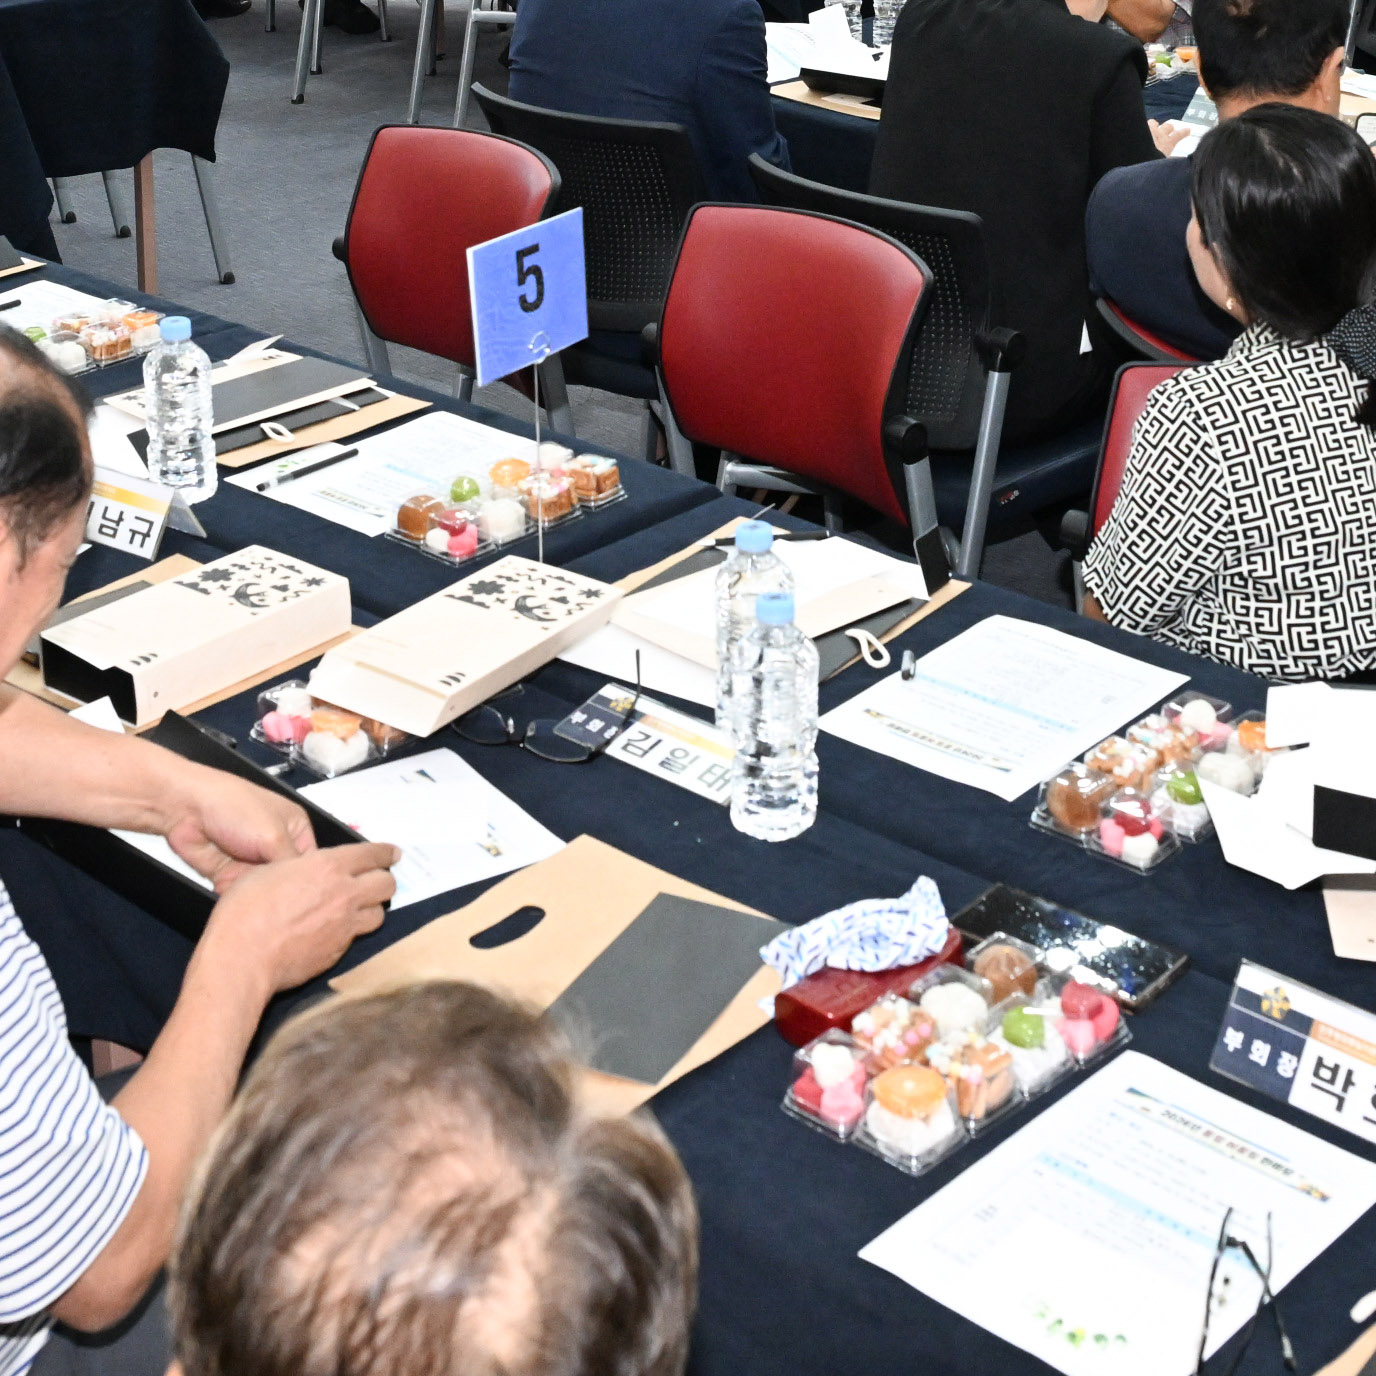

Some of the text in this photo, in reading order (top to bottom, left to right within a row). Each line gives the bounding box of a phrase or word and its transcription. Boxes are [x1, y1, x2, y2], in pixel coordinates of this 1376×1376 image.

[516, 242, 545, 314] 5
[621, 730, 733, 793] 김일태
[1223, 1026, 1299, 1079] 부회장
